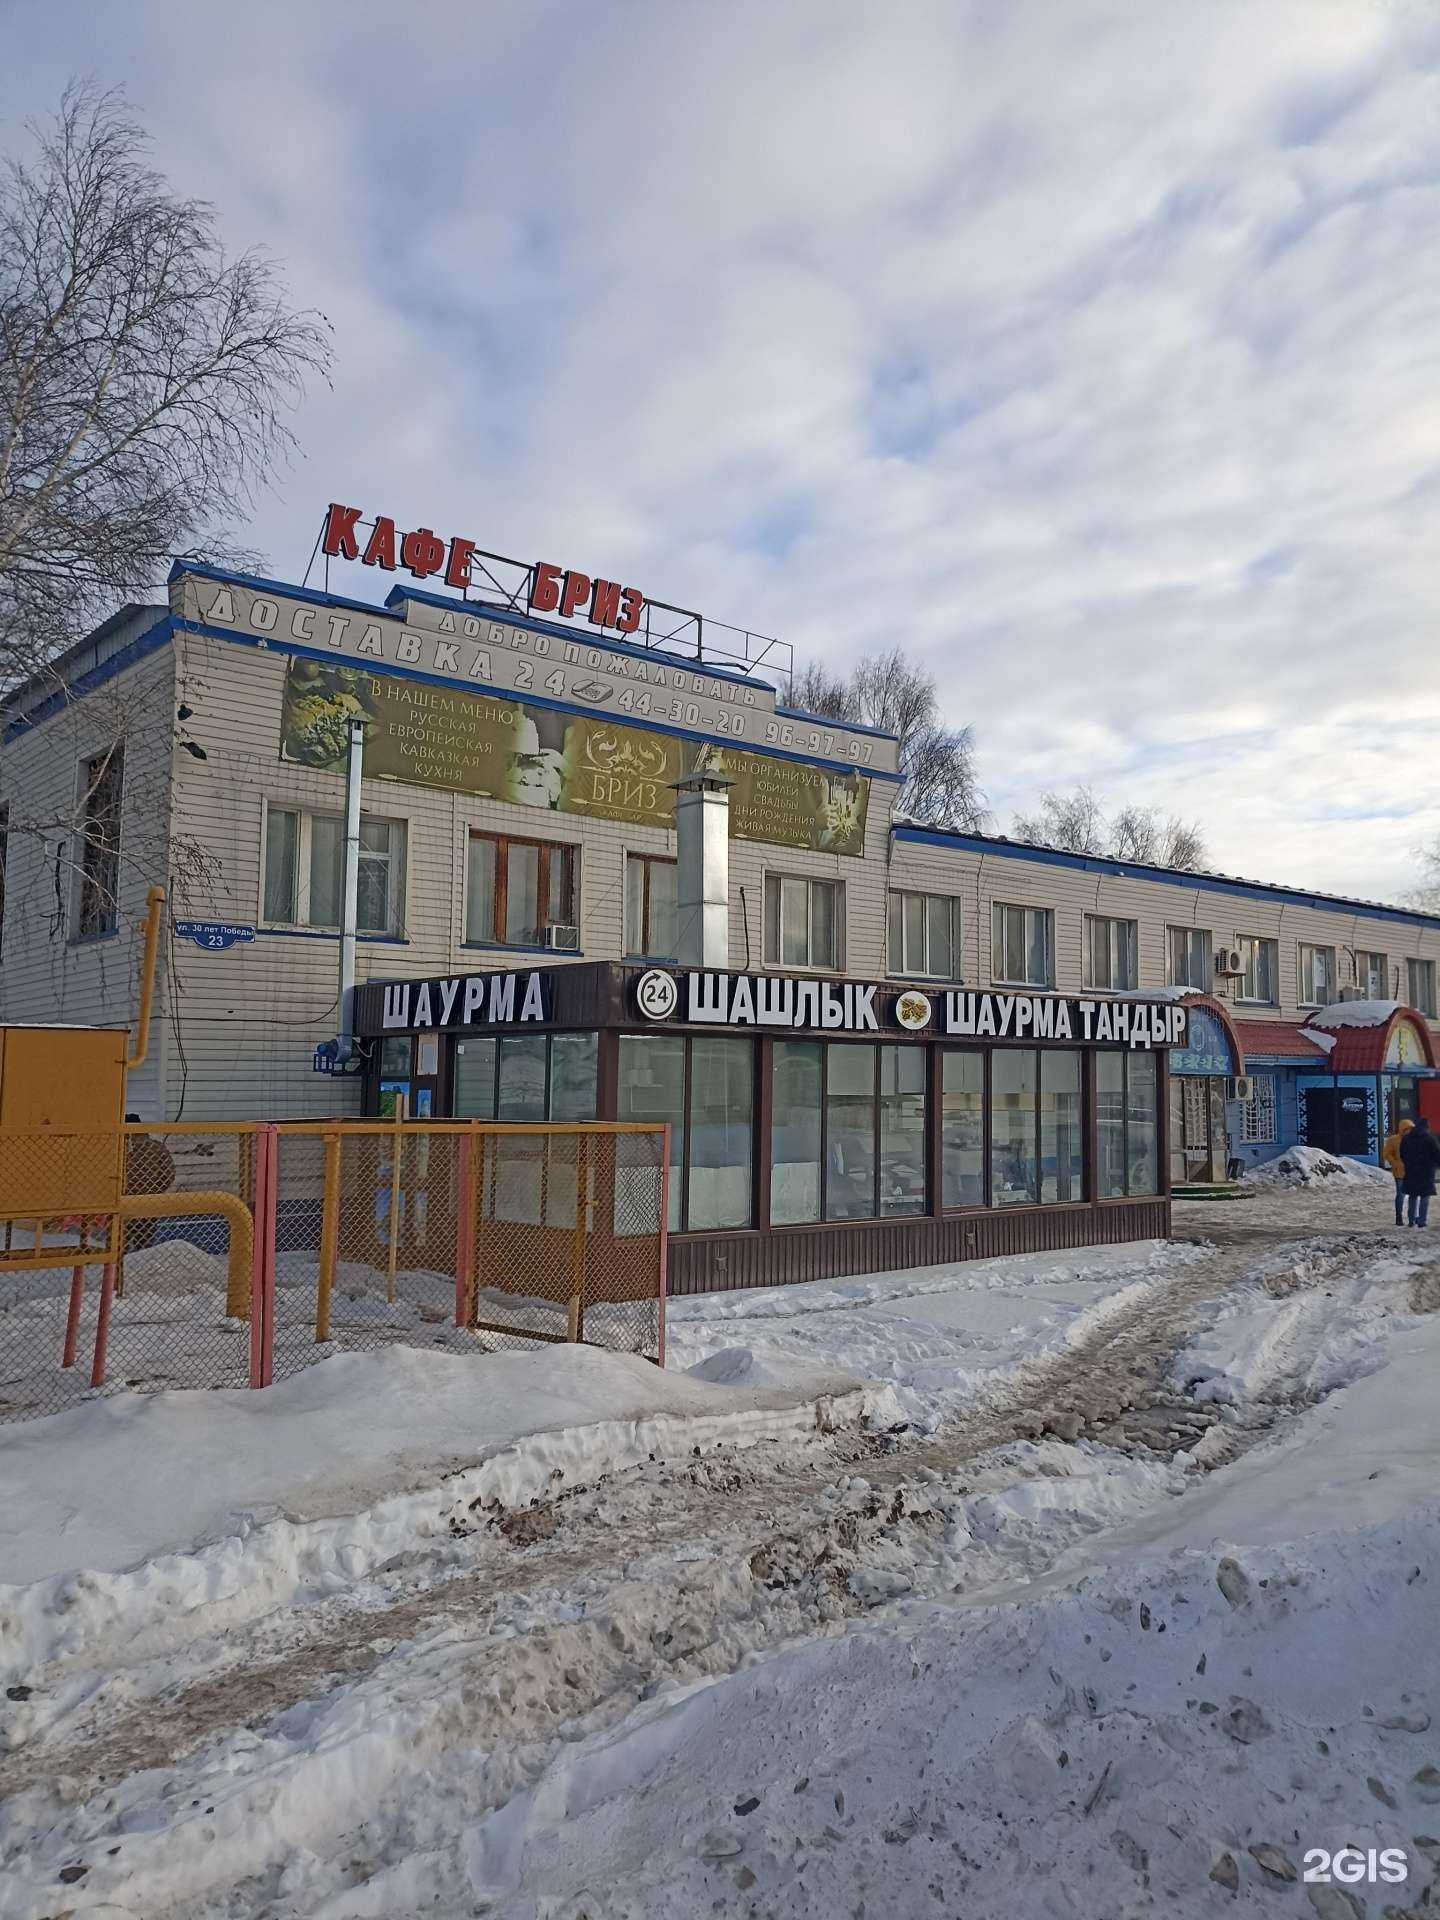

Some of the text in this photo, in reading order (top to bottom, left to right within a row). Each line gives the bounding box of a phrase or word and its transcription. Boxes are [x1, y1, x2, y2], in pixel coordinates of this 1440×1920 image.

[322, 503, 643, 633] КАФЕ БРИЗ
[439, 612, 756, 706] ДОБРО ПОЖАЛОВАТЬ
[206, 589, 873, 764] ДОСТАВКА 24 44-30-20 96-97-97
[371, 680, 513, 724] В НАШЕМ МЕНЮ
[410, 711, 476, 733] РУССКАЯ
[400, 742, 479, 767] КАВКАЗКАЯ
[725, 759, 747, 772] МЫ
[414, 763, 462, 781] КУХНЯ
[592, 775, 656, 808] БРИЗ
[735, 806, 815, 827] ДНИ РОЖДЕНИЯ
[736, 820, 771, 832] ЖИВАЯ
[208, 935, 223, 946] 23
[221, 927, 254, 936] Победы
[383, 972, 544, 1028] ШАУРМА
[646, 985, 668, 1003] 24
[688, 972, 1186, 1048] ШАШЛЫК ШАУРМА ТАНДЫР
